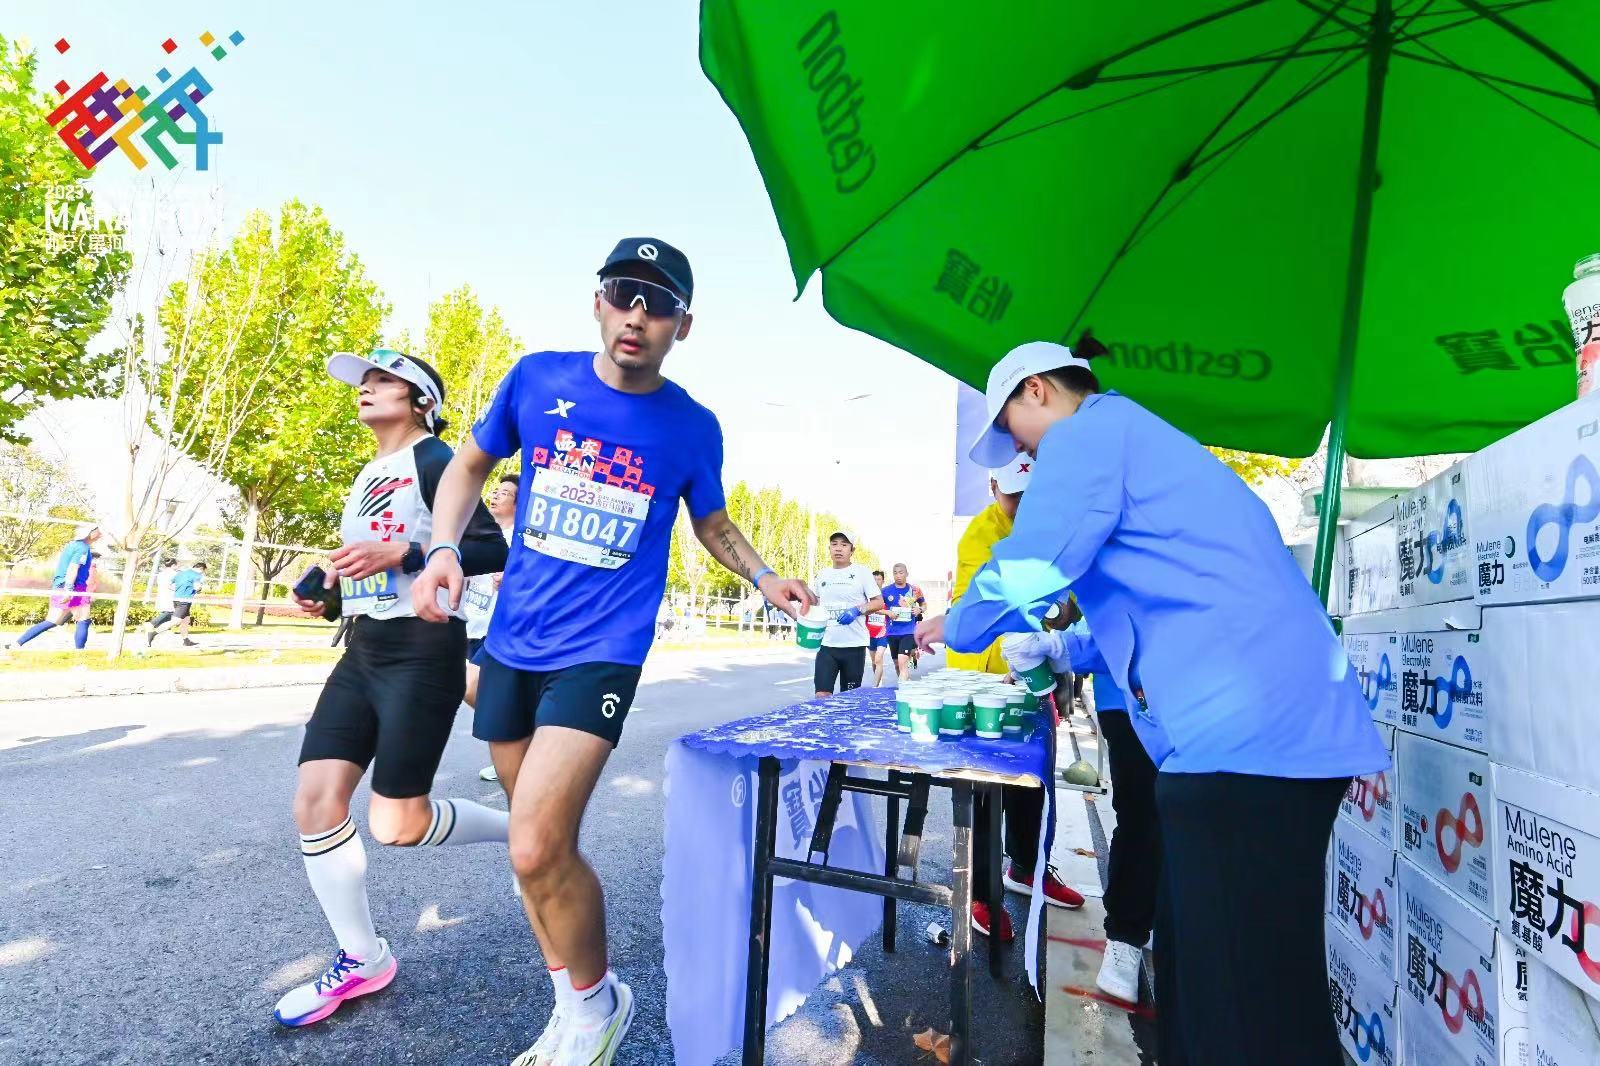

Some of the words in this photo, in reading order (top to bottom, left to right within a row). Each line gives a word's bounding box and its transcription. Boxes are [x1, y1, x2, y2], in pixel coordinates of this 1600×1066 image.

[559, 484, 596, 506] 2023
[529, 495, 638, 549] B18047
[1400, 530, 1435, 582] 魔力
[1476, 539, 1501, 553] Mulene
[1478, 559, 1505, 588] 魔力
[1401, 635, 1434, 654] Mulene
[1402, 653, 1431, 669] Electrolyte
[1402, 668, 1438, 716] 魔力
[1338, 837, 1362, 871] Mulene
[1404, 821, 1422, 850] 魔力
[1505, 806, 1577, 860] Mulene
[1507, 836, 1544, 864] Amino
[1546, 851, 1574, 878] Acid
[1338, 869, 1363, 927] 魔力
[1406, 892, 1443, 941] Mulene
[1509, 858, 1585, 954] 魔力
[1406, 914, 1427, 941] Amino
[1427, 931, 1442, 954] Acid
[1511, 919, 1543, 954] 氨基酸
[1329, 944, 1357, 987] Mulene
[1408, 932, 1447, 1011] 魔力
[1329, 977, 1359, 1046] 魔力
[1466, 1006, 1495, 1047] 运动饮料
